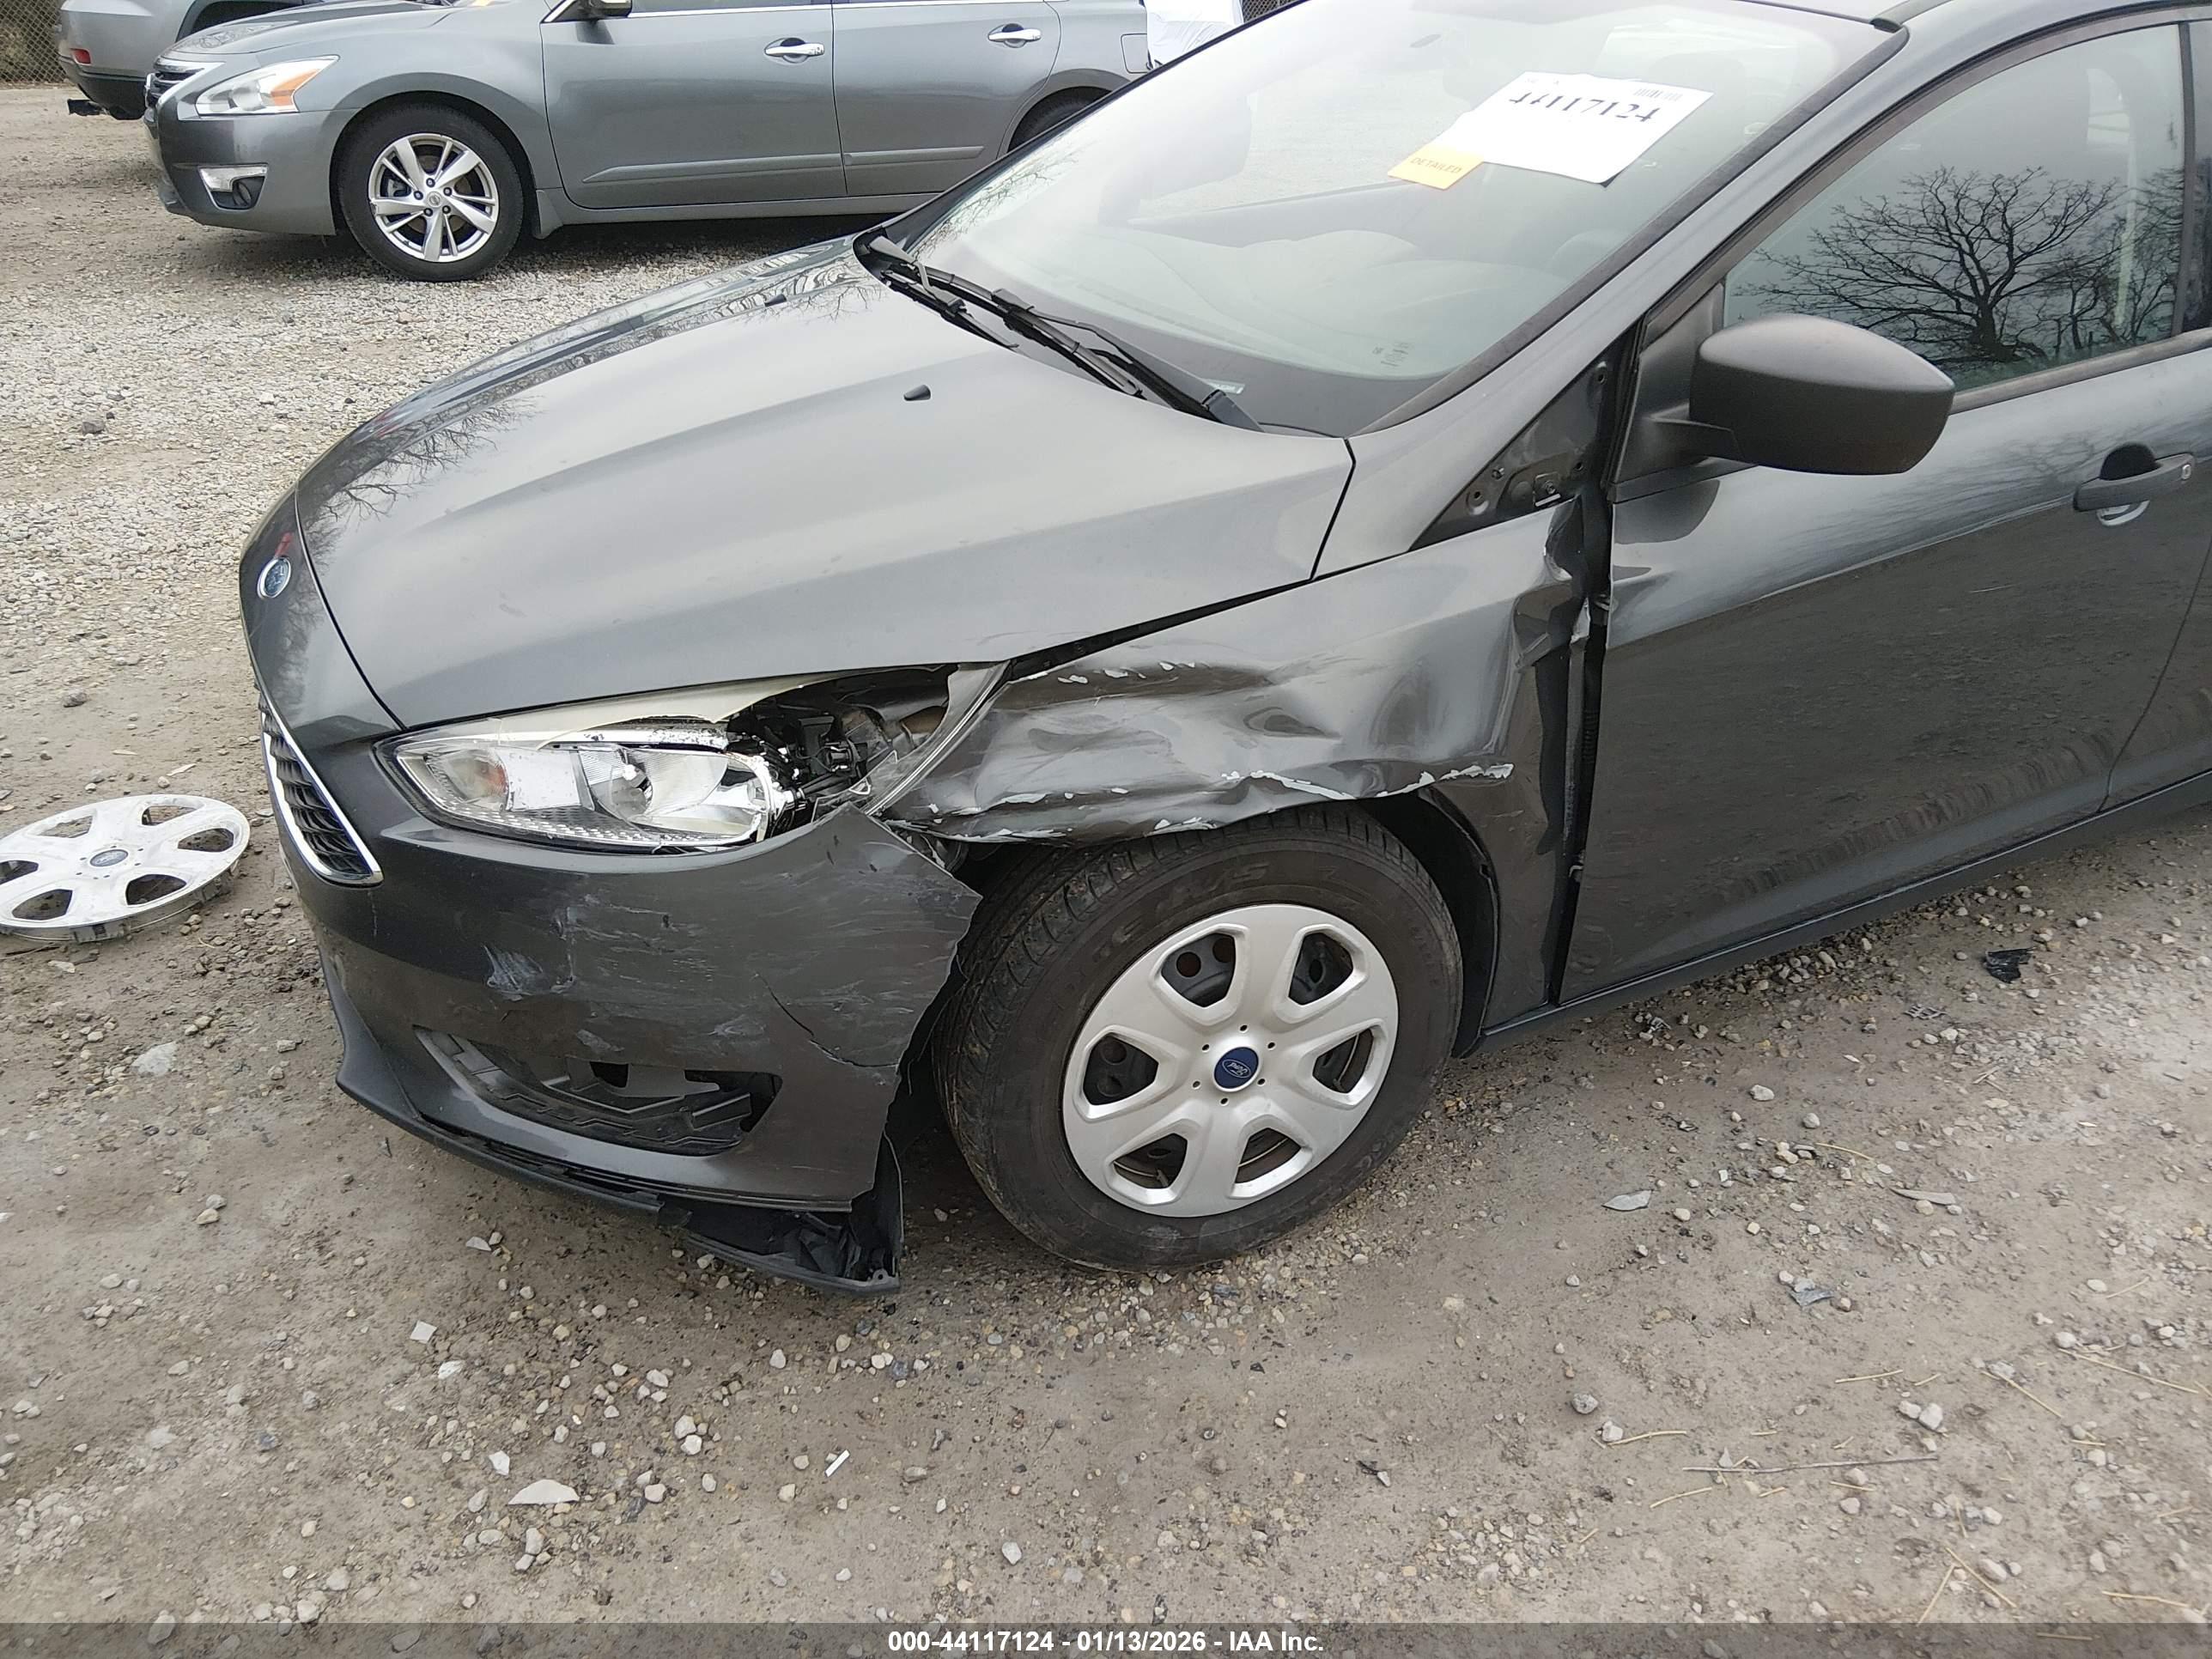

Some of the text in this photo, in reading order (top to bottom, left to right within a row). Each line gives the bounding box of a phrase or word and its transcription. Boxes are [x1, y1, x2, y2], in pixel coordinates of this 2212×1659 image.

[1509, 92, 1661, 122] 44117124
[1411, 157, 1463, 173] DETAILED
[1227, 1063, 1248, 1076] Ford
